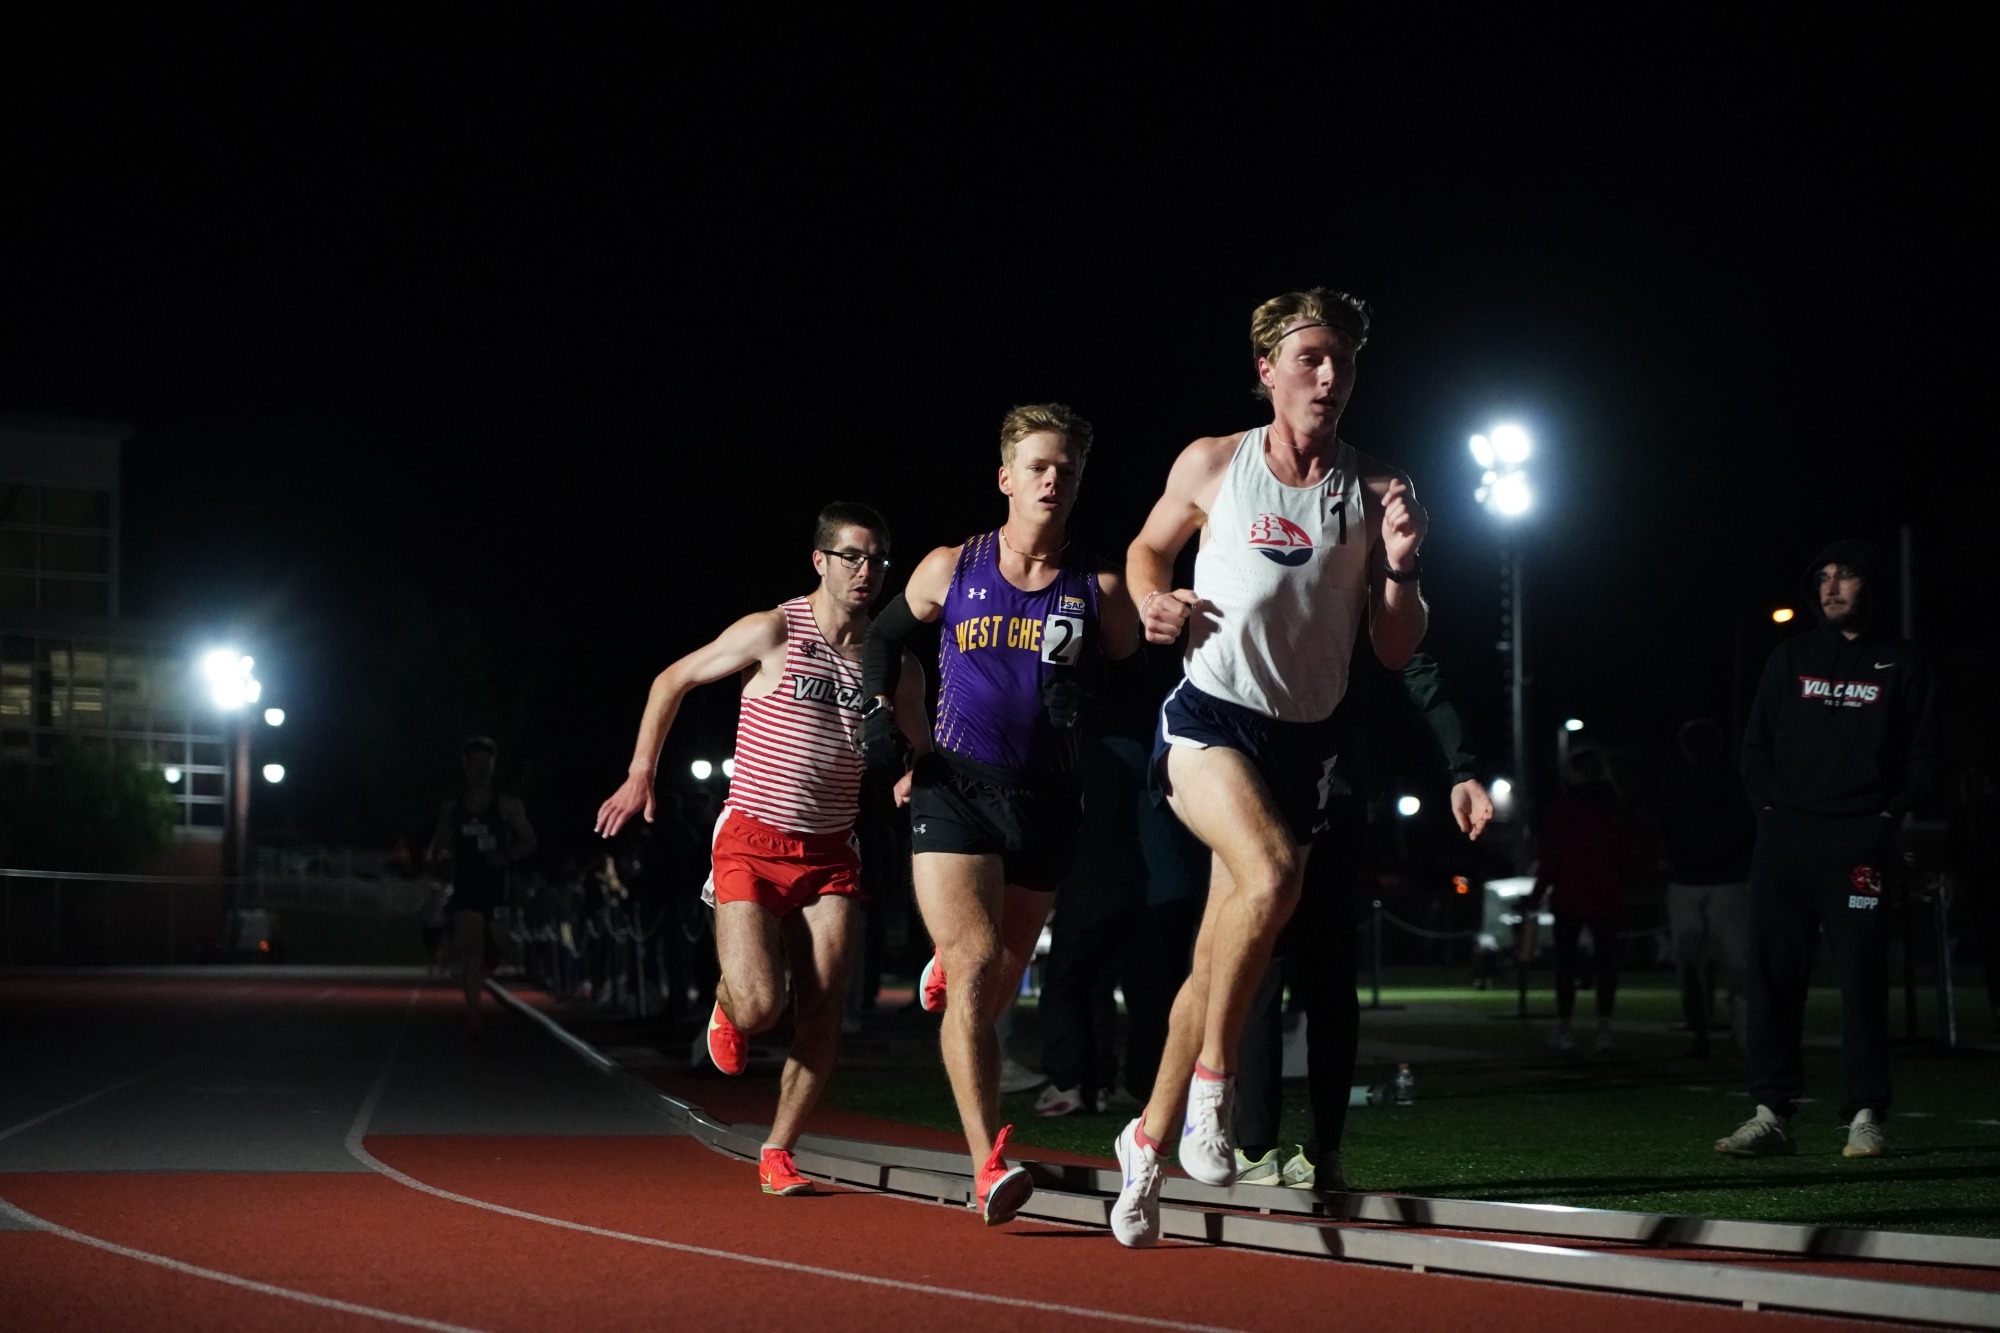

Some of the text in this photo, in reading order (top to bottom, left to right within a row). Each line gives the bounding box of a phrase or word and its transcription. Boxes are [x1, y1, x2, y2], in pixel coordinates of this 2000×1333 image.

[1330, 501, 1347, 545] 1
[1060, 601, 1085, 610] PSAC
[955, 615, 1047, 654] WEST CHE
[1048, 619, 1074, 663] 2
[1803, 679, 1880, 701] VULCANS
[1848, 895, 1879, 909] BOPP
